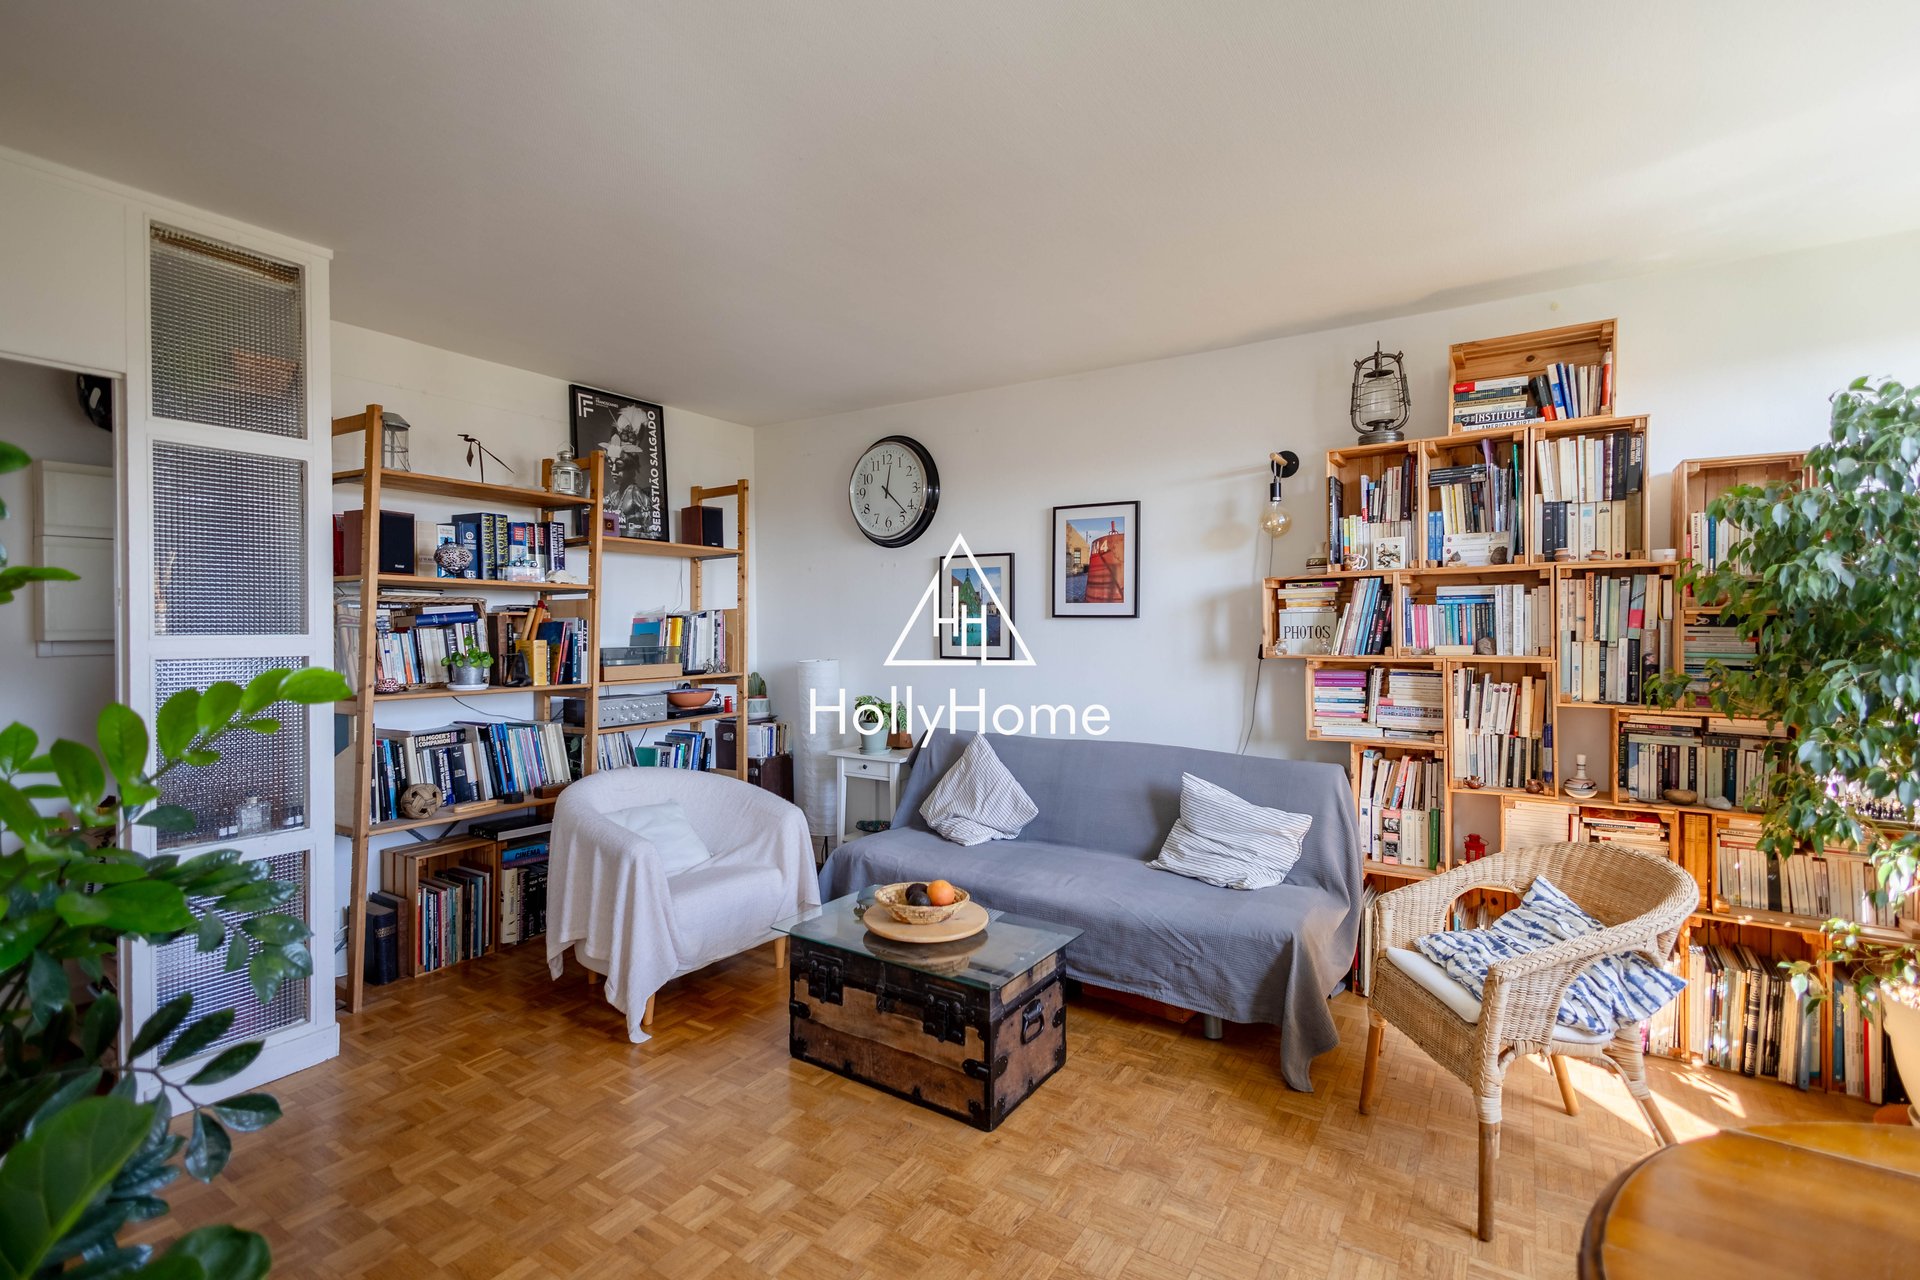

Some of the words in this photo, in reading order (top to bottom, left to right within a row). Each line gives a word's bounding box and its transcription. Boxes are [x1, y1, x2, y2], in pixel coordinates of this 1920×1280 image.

[1475, 410, 1524, 424] INSTITUTE
[647, 411, 658, 467] SALGADO
[882, 454, 892, 465] 12
[898, 456, 902, 468] 1
[872, 460, 880, 472] 11
[906, 466, 912, 476] 2
[863, 474, 873, 485] 10
[912, 482, 919, 493] 3
[860, 488, 866, 500] 9
[649, 469, 662, 532] SEBASTIÃO
[908, 498, 914, 510] 4
[864, 504, 870, 514] 8
[874, 514, 880, 524] 7
[885, 516, 892, 528] 6
[900, 511, 906, 522] 5
[482, 515, 491, 554] ROBERT
[496, 517, 505, 555] ROBERT
[1283, 625, 1331, 640] PHOTOS
[418, 732, 450, 742] FILMGOER'S
[418, 738, 450, 748] COMPANION
[1712, 739, 1738, 747] KING
